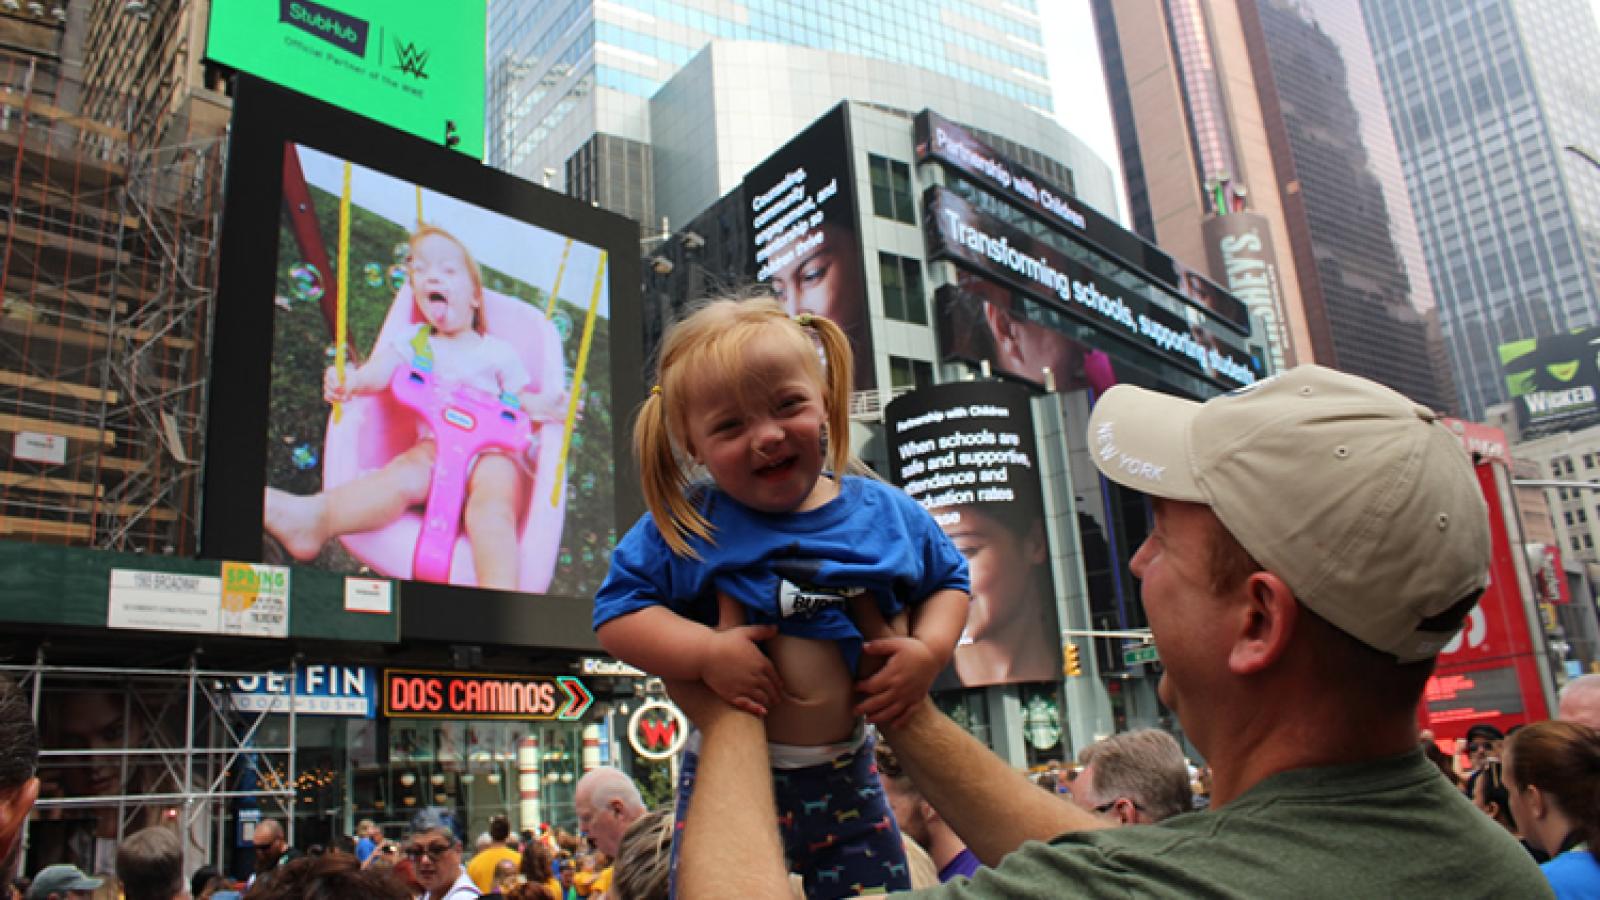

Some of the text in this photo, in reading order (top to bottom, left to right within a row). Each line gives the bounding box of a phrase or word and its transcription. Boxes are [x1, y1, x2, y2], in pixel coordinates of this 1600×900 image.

[289, 2, 358, 43] StubHub
[936, 127, 1086, 230] Partnership with Children
[944, 208, 1071, 301] Transforming
[1071, 280, 1138, 333] schools,
[1138, 314, 1208, 369] supporting
[896, 404, 1010, 433] Partnership with Children
[898, 429, 1021, 459] When schools are
[1096, 421, 1167, 479] NEW YORK
[901, 448, 1031, 479] safe and supportive,
[979, 466, 1008, 483] and
[977, 486, 1014, 502] rates
[227, 568, 285, 588] SPRING
[305, 665, 367, 695] FIN
[391, 678, 556, 714] DOS CAMINOS
